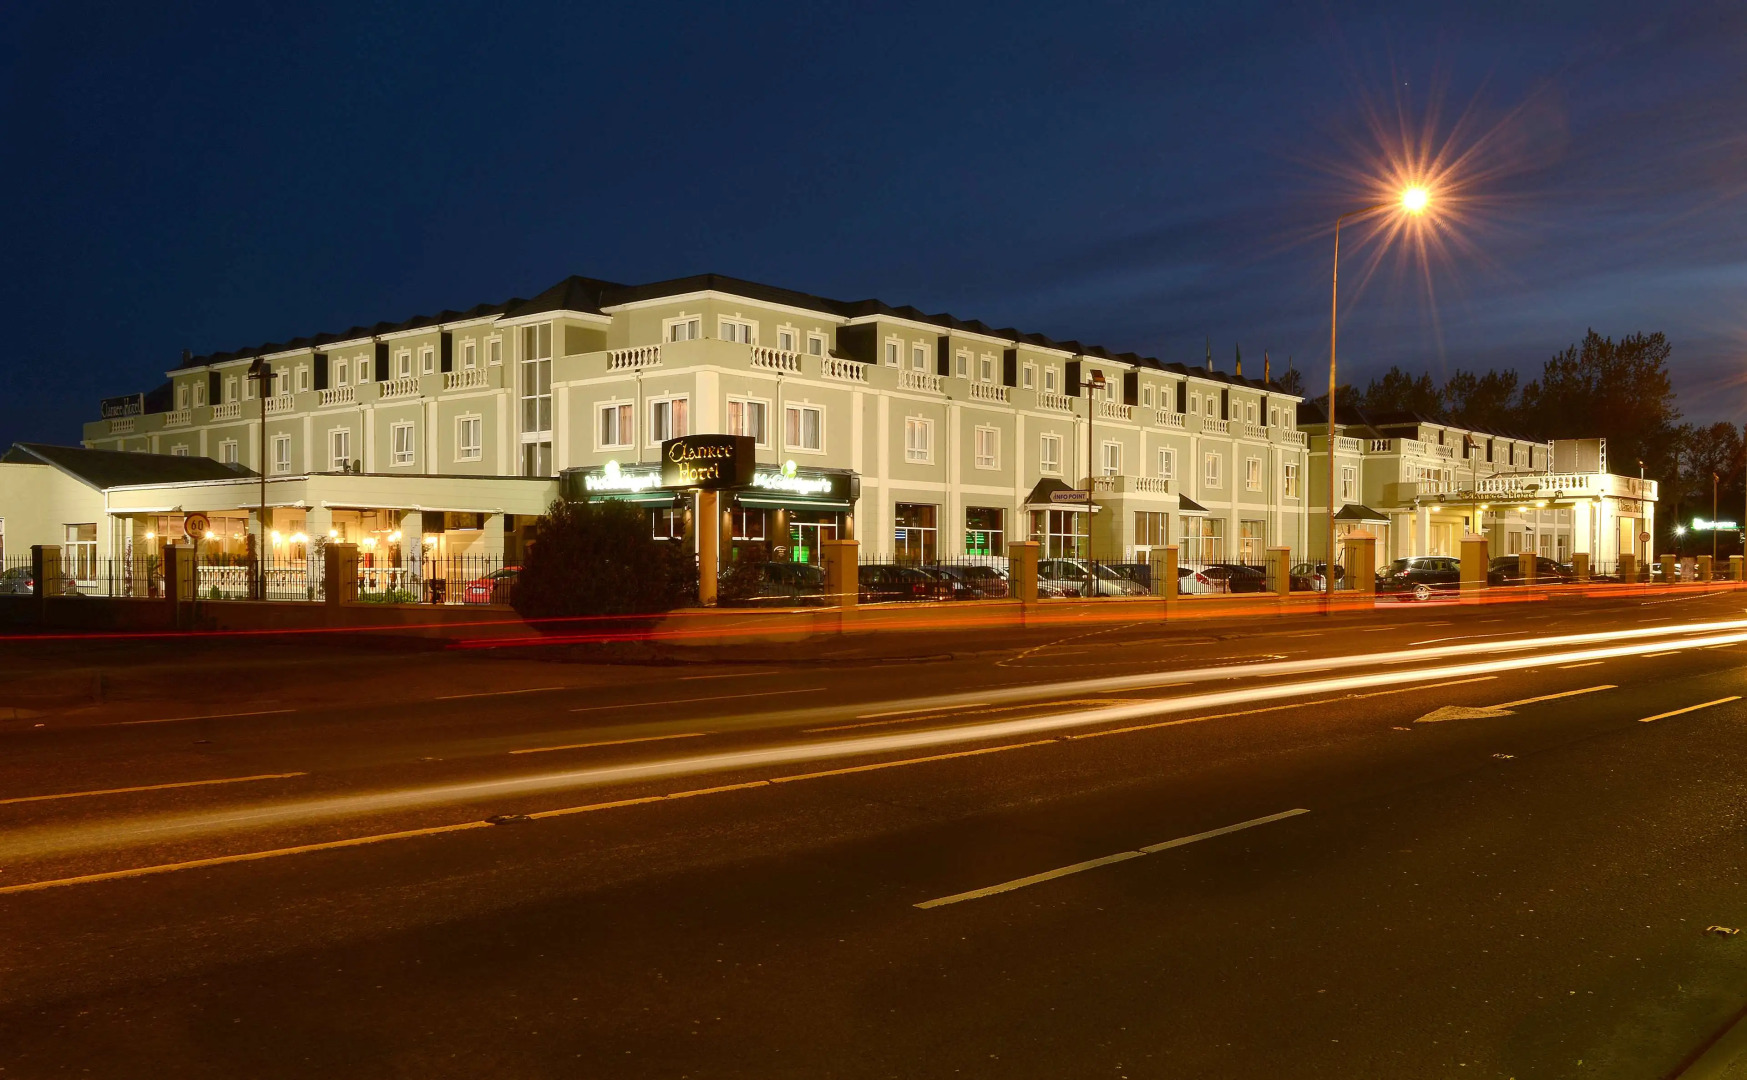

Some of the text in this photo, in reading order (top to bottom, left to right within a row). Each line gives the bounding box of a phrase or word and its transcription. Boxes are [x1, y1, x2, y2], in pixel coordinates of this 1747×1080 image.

[669, 440, 733, 463] Clanree
[678, 462, 720, 482] Hotel
[191, 519, 204, 531] 60
